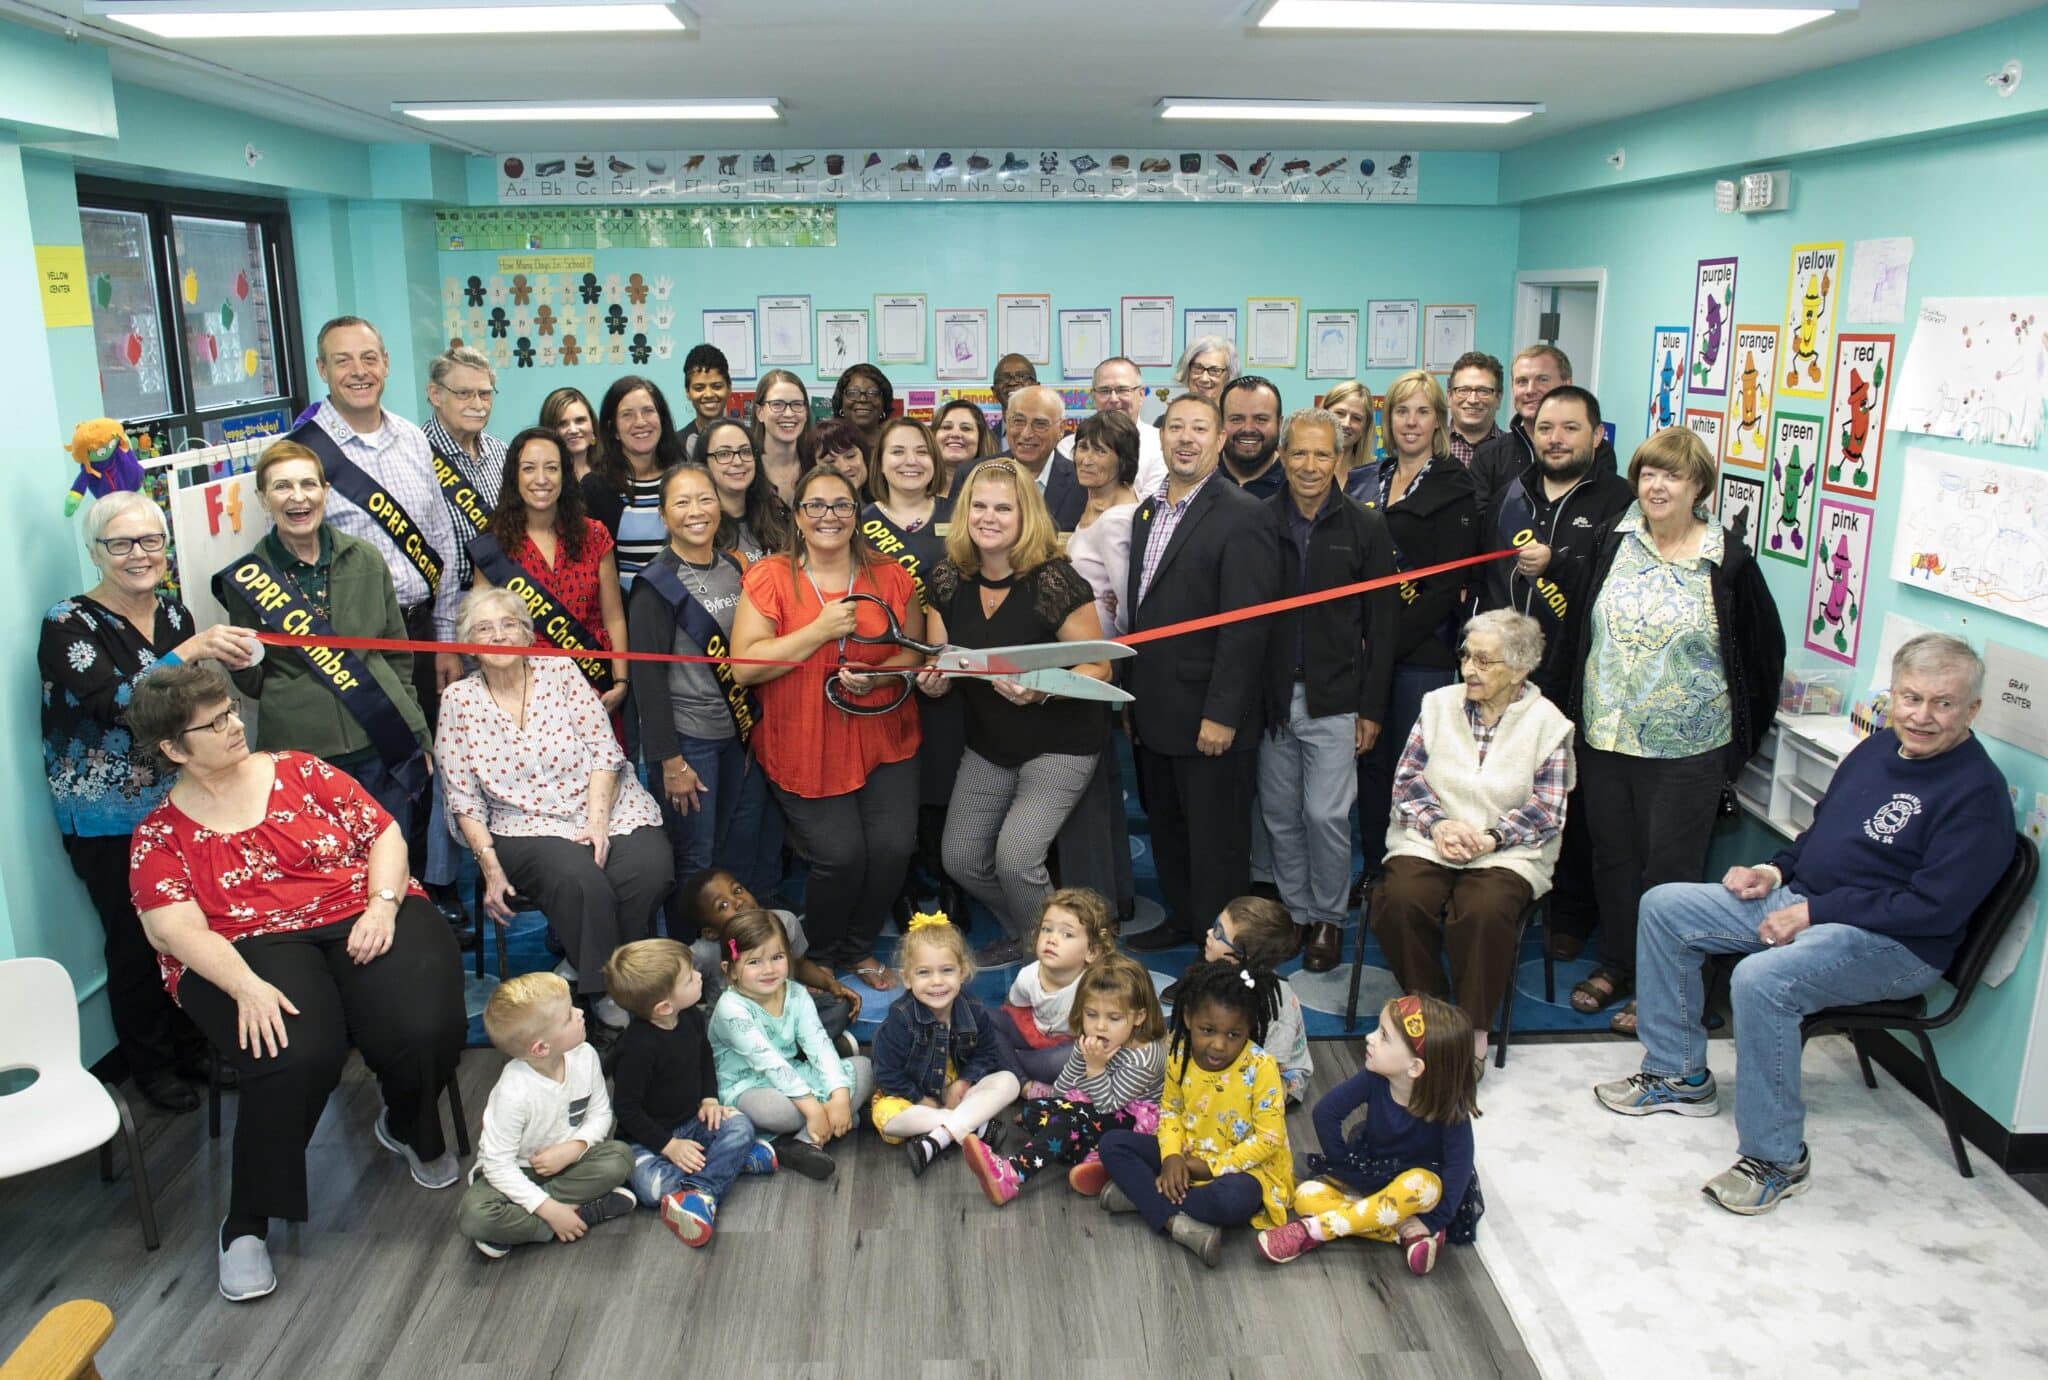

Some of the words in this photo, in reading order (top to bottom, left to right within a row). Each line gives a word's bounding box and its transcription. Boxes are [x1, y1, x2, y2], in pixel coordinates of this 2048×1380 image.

[506, 183, 526, 196] Aa
[541, 182, 561, 195] Bb
[577, 181, 597, 195] Cc
[611, 181, 632, 195] Dd
[685, 180, 701, 193] Ff
[718, 179, 740, 199] Gg
[754, 178, 775, 193] Hh
[827, 178, 844, 198] Jj
[862, 178, 880, 192] Kk
[929, 178, 956, 192] Mm
[968, 179, 989, 192] Nn
[1003, 178, 1024, 192] Oo
[1040, 178, 1059, 198] Pp
[1073, 178, 1095, 198] Qq
[1146, 179, 1164, 193] Ss
[1184, 179, 1199, 193] Tt
[1215, 180, 1235, 194] Uu
[1252, 180, 1269, 194] Vv
[1281, 180, 1309, 194] Ww
[1320, 180, 1340, 194] Xx
[1357, 181, 1373, 200] Yy
[1392, 181, 1408, 196] Zz
[499, 258, 514, 270] How
[516, 258, 533, 273] Many
[534, 257, 550, 272] Days
[552, 257, 562, 269] In
[1797, 250, 1836, 274] yellow
[47, 271, 69, 281] YELLOW
[1702, 265, 1732, 285] purple
[49, 284, 71, 294] CENTER
[1662, 335, 1680, 350] blue
[1739, 334, 1775, 353] orange
[1854, 343, 1875, 362] red
[244, 419, 279, 436] Birthday!
[1692, 417, 1716, 434] white
[1781, 422, 1813, 443] green
[431, 452, 461, 488] PRF
[1729, 483, 1755, 503] black
[368, 492, 409, 536] OPRF
[1831, 510, 1858, 532] pink
[863, 520, 904, 554] OPRF
[234, 562, 292, 612] OPRF
[506, 576, 553, 618] OPRF
[703, 597, 733, 614] Byline
[2008, 678, 2030, 693] GRAY
[2002, 692, 2032, 710] CENTER
